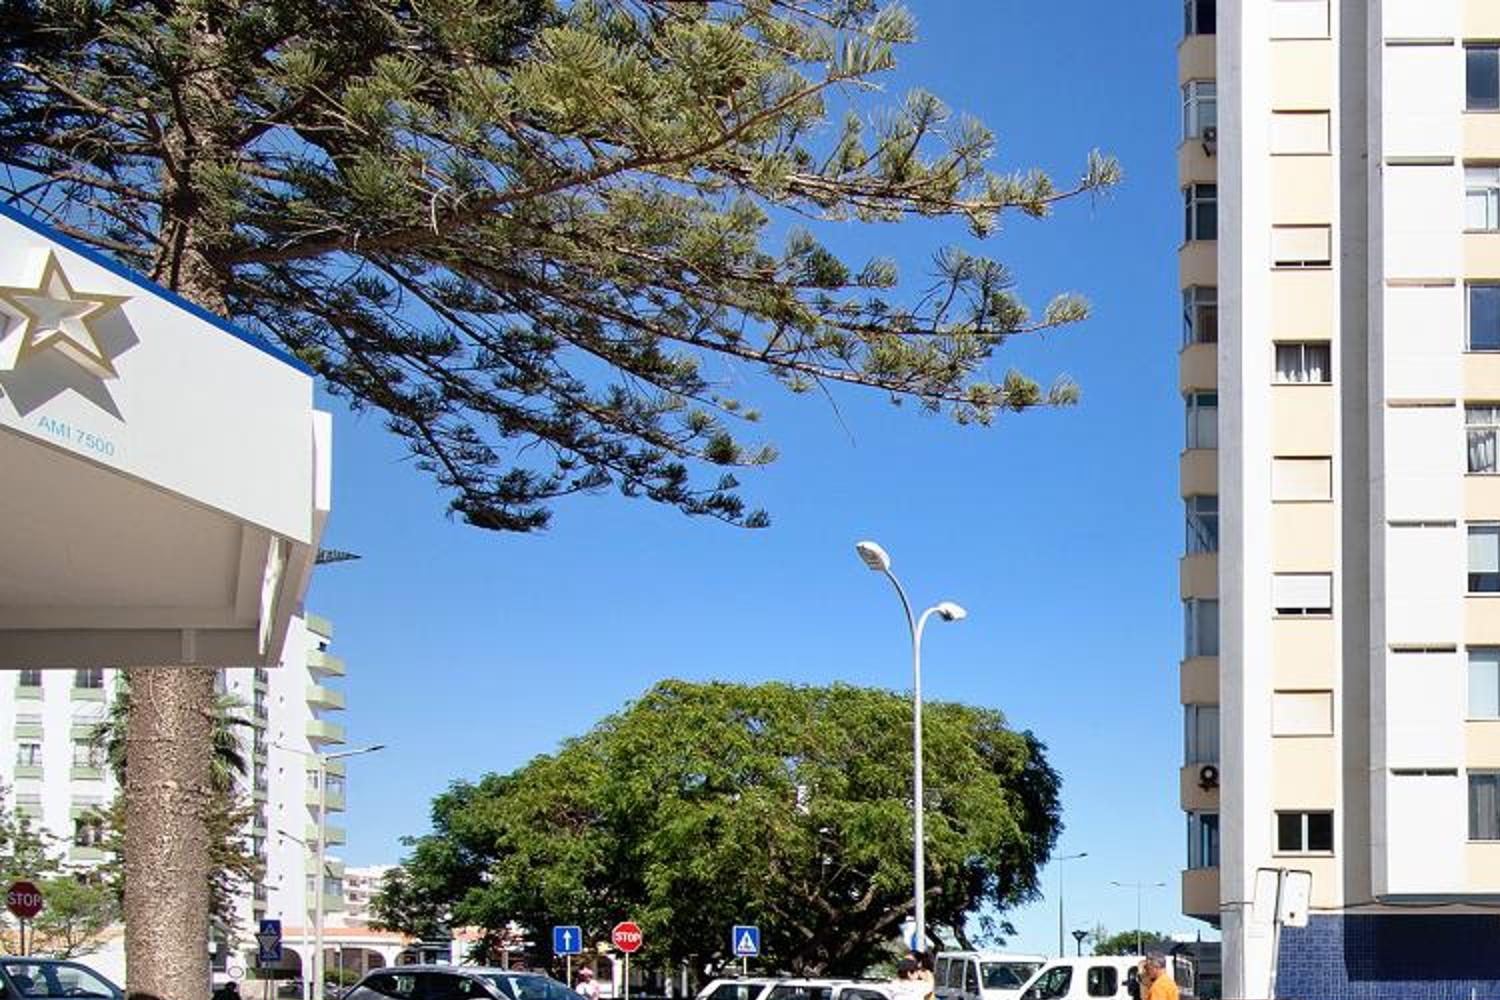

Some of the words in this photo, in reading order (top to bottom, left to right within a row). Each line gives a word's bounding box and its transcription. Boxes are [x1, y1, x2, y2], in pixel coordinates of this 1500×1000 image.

[38, 415, 71, 440] AMI
[76, 429, 115, 457] 7500
[8, 891, 41, 907] STOP
[615, 931, 641, 943] STOP
